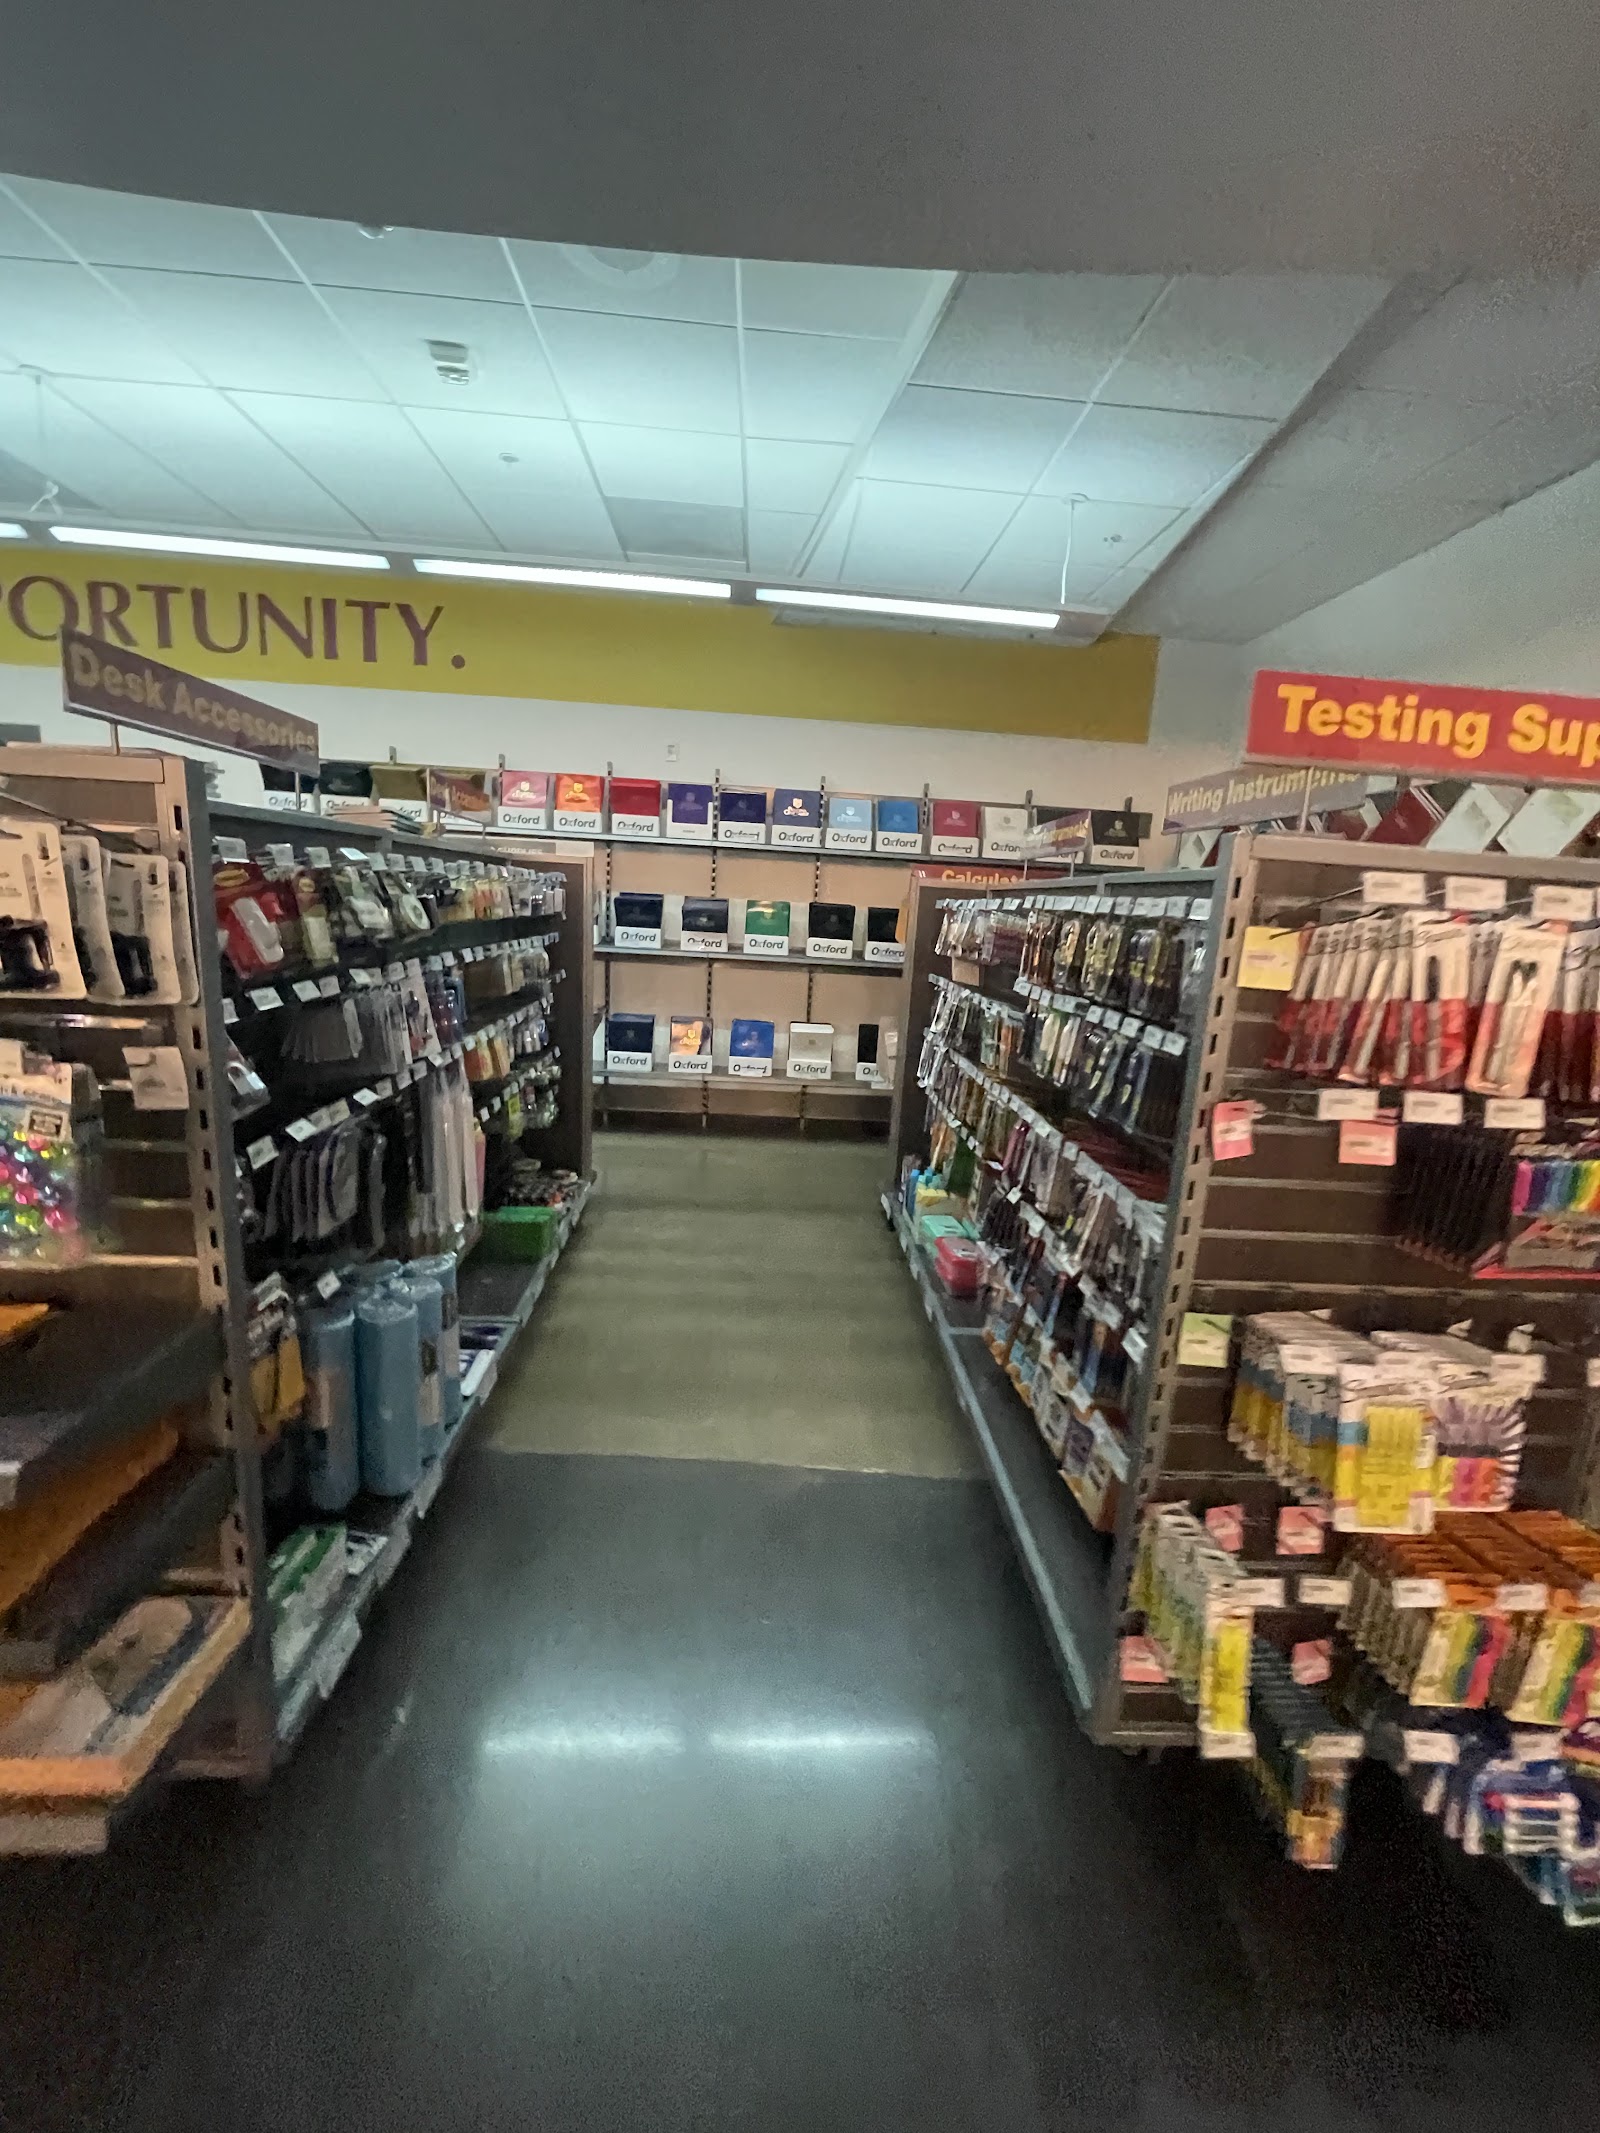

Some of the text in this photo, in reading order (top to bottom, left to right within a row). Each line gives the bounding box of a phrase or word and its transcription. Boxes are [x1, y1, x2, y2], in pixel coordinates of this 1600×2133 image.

[0, 575, 466, 669] ORTUNITY.
[69, 641, 316, 753] Desk Accessories
[1277, 683, 1492, 759] Testing
[1168, 785, 1224, 815] Writing
[502, 813, 541, 825] Oxford
[559, 817, 597, 829] Oxford
[778, 831, 815, 843] Oxford
[832, 832, 868, 844] Oxford
[881, 837, 918, 848] Oxford
[620, 931, 657, 942] Oxford
[749, 938, 785, 949] Oxford
[813, 943, 848, 954] Oxford
[612, 1055, 648, 1066] Oxford
[673, 1060, 709, 1070] Oxford
